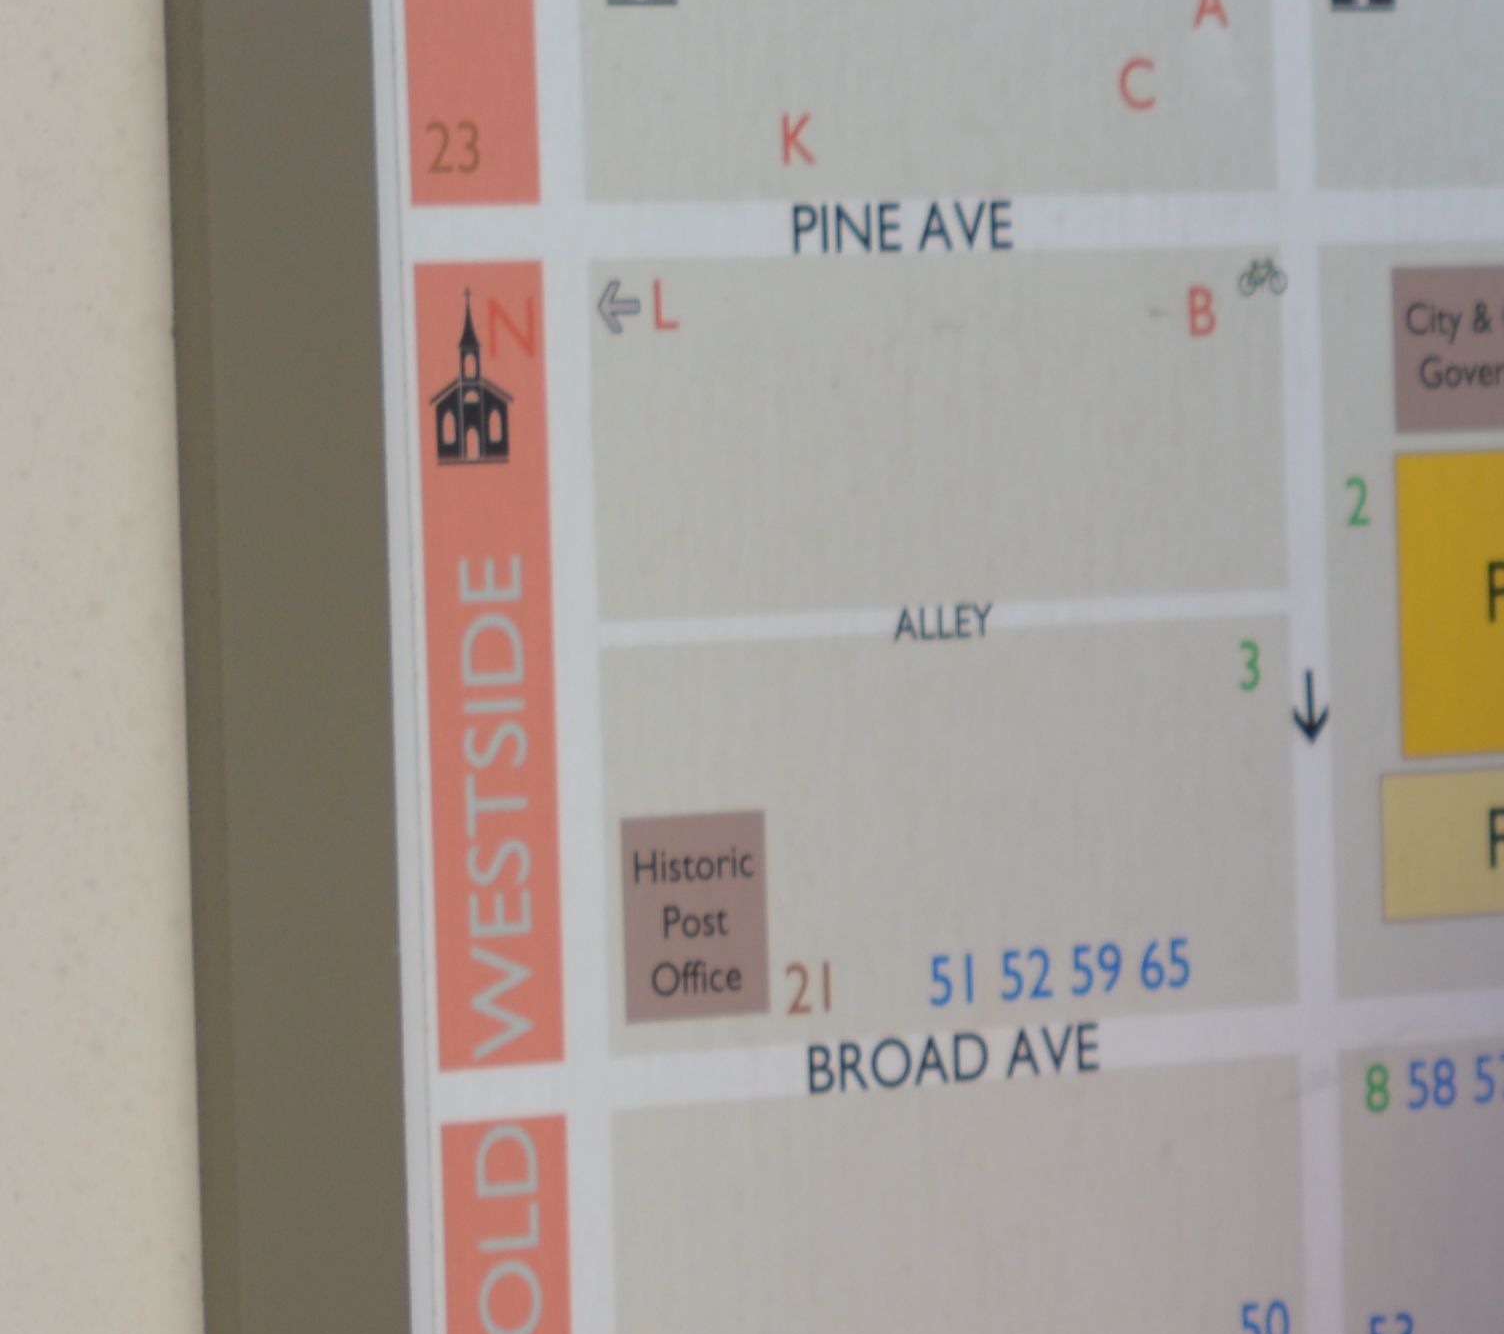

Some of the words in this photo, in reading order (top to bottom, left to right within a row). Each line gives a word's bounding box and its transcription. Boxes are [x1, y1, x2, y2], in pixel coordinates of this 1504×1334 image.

[1118, 57, 1156, 111] C
[425, 120, 481, 175] 23
[782, 114, 816, 167] K
[792, 202, 903, 256] PINE
[919, 200, 1015, 252] AVE
[487, 296, 539, 359] N
[653, 279, 680, 331] L
[1187, 286, 1217, 337] B
[1405, 301, 1463, 342] City
[1473, 301, 1491, 334] &
[1344, 475, 1371, 528] 2
[894, 603, 993, 642] ALLEY
[1238, 640, 1262, 692] 3
[459, 553, 535, 1060] WESTSIDE
[632, 846, 754, 884] Historic
[661, 907, 729, 940] Post
[651, 961, 743, 998] Office
[785, 962, 831, 1016] 21
[929, 953, 975, 1007] 51
[1000, 946, 1053, 1001] 52
[1070, 942, 1123, 995] 59
[1140, 936, 1192, 991] 65
[806, 1033, 989, 1096] BROAD
[1006, 1022, 1101, 1079] AVE
[1364, 1063, 1391, 1114] 8
[1406, 1057, 1458, 1110] 58
